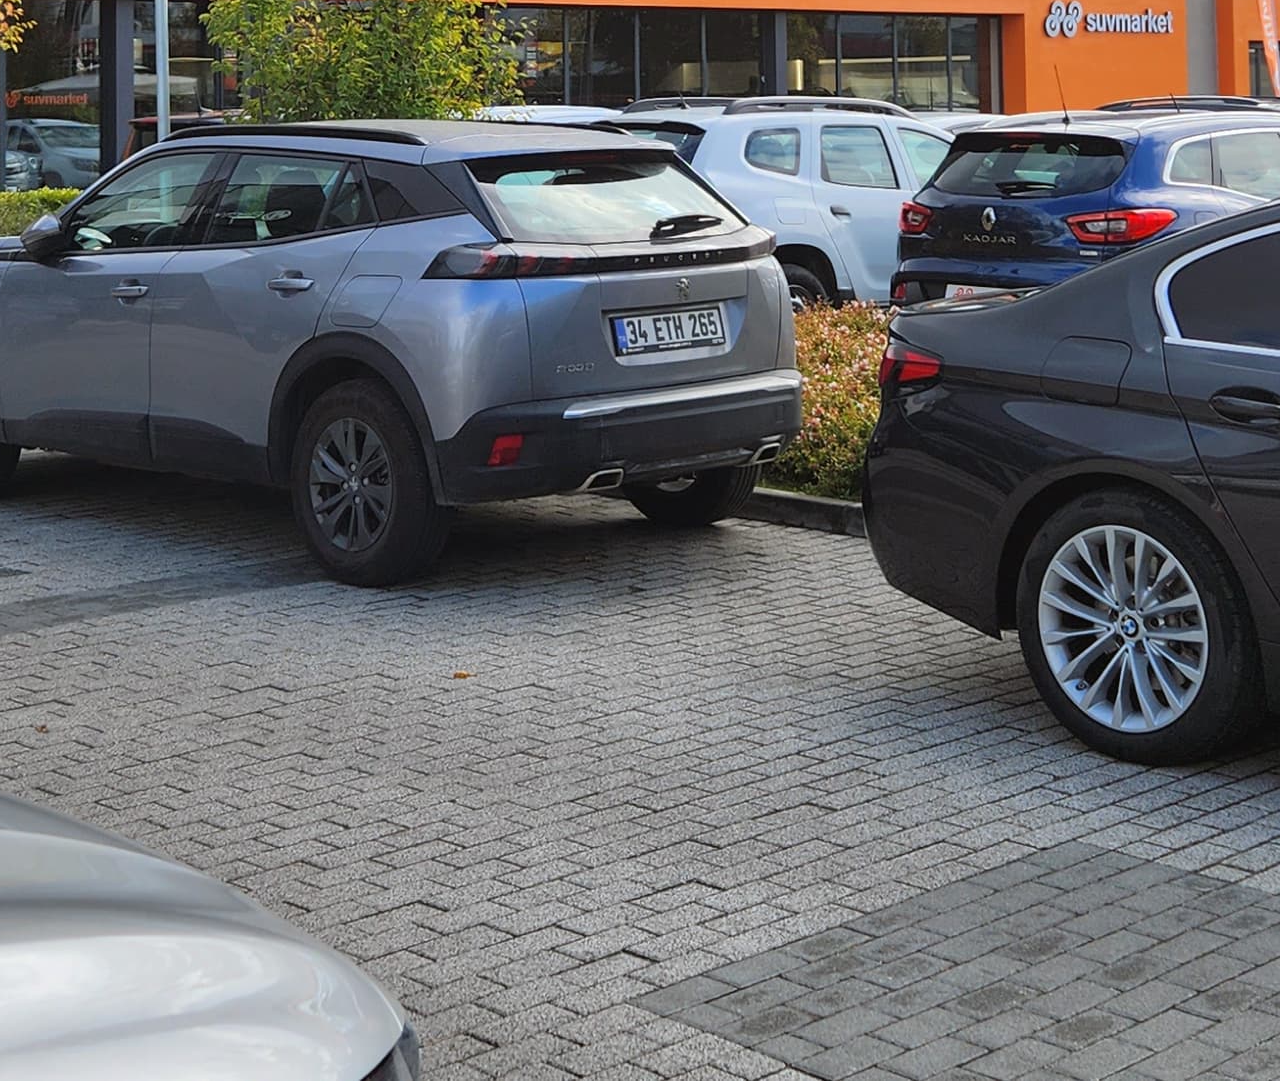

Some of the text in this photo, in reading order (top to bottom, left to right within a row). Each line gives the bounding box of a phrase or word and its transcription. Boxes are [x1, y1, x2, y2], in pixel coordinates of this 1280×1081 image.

[1085, 8, 1174, 34] suvmarket
[626, 312, 719, 345] 34 ETH 265
